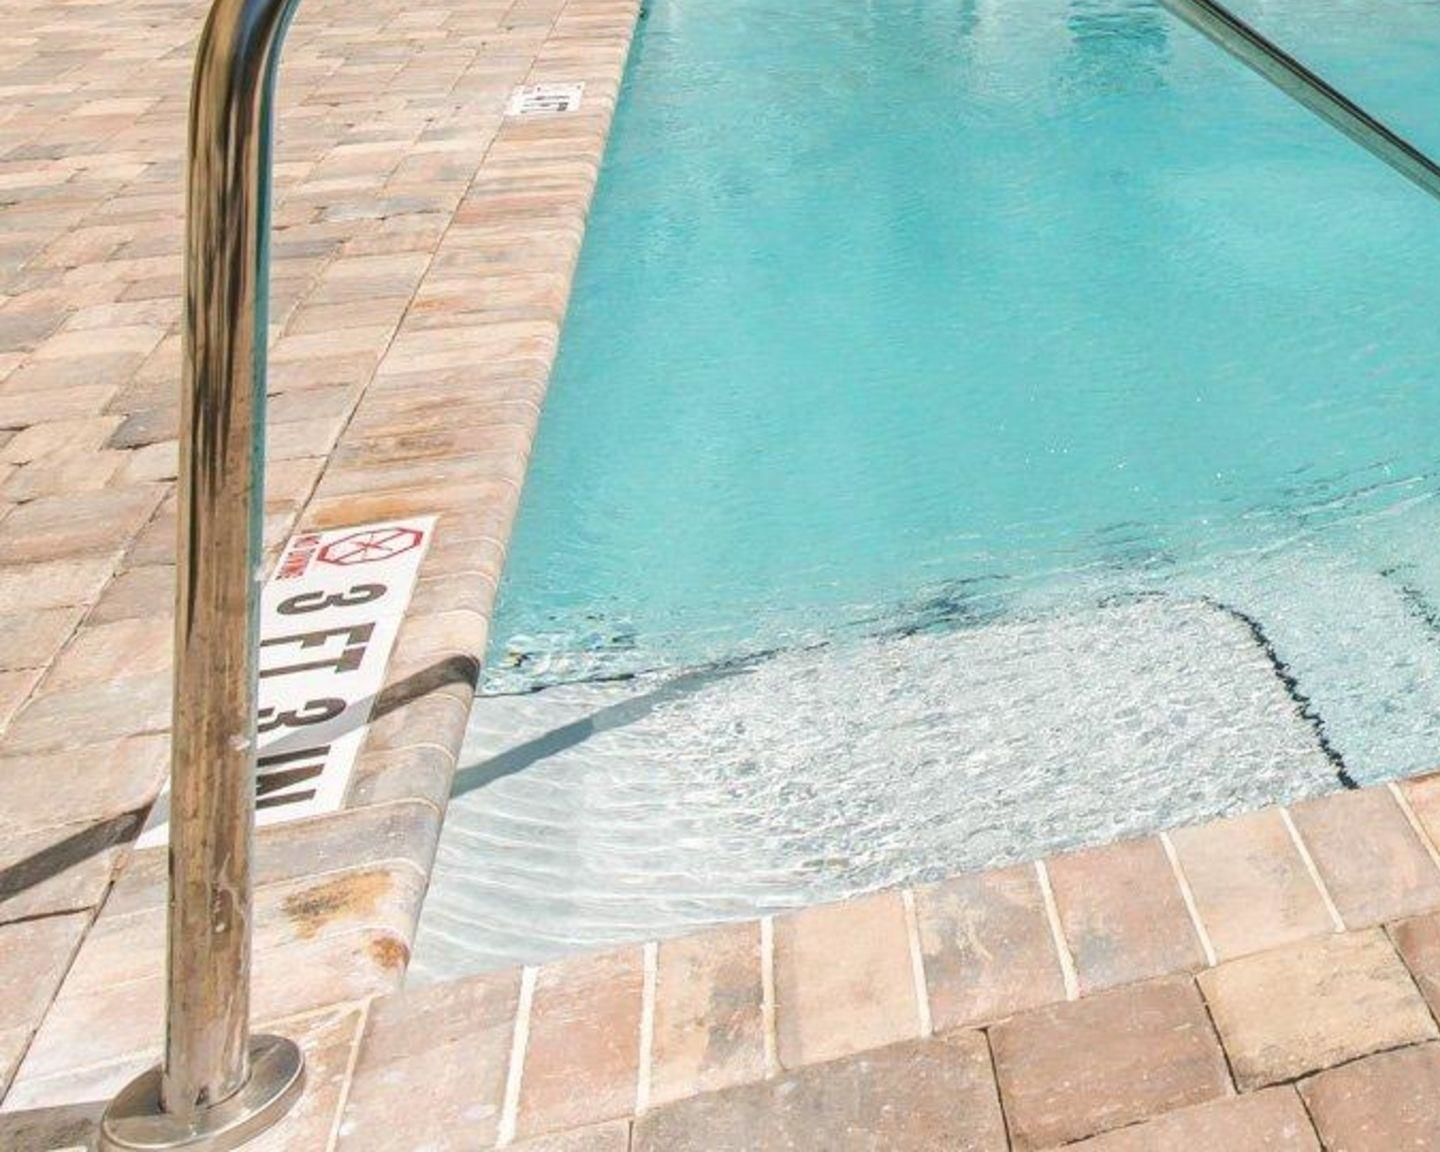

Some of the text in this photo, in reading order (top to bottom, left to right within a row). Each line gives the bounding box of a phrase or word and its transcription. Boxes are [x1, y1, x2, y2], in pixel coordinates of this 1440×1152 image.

[276, 583, 388, 615] 3
[259, 622, 376, 678] FT
[257, 697, 346, 733] 3
